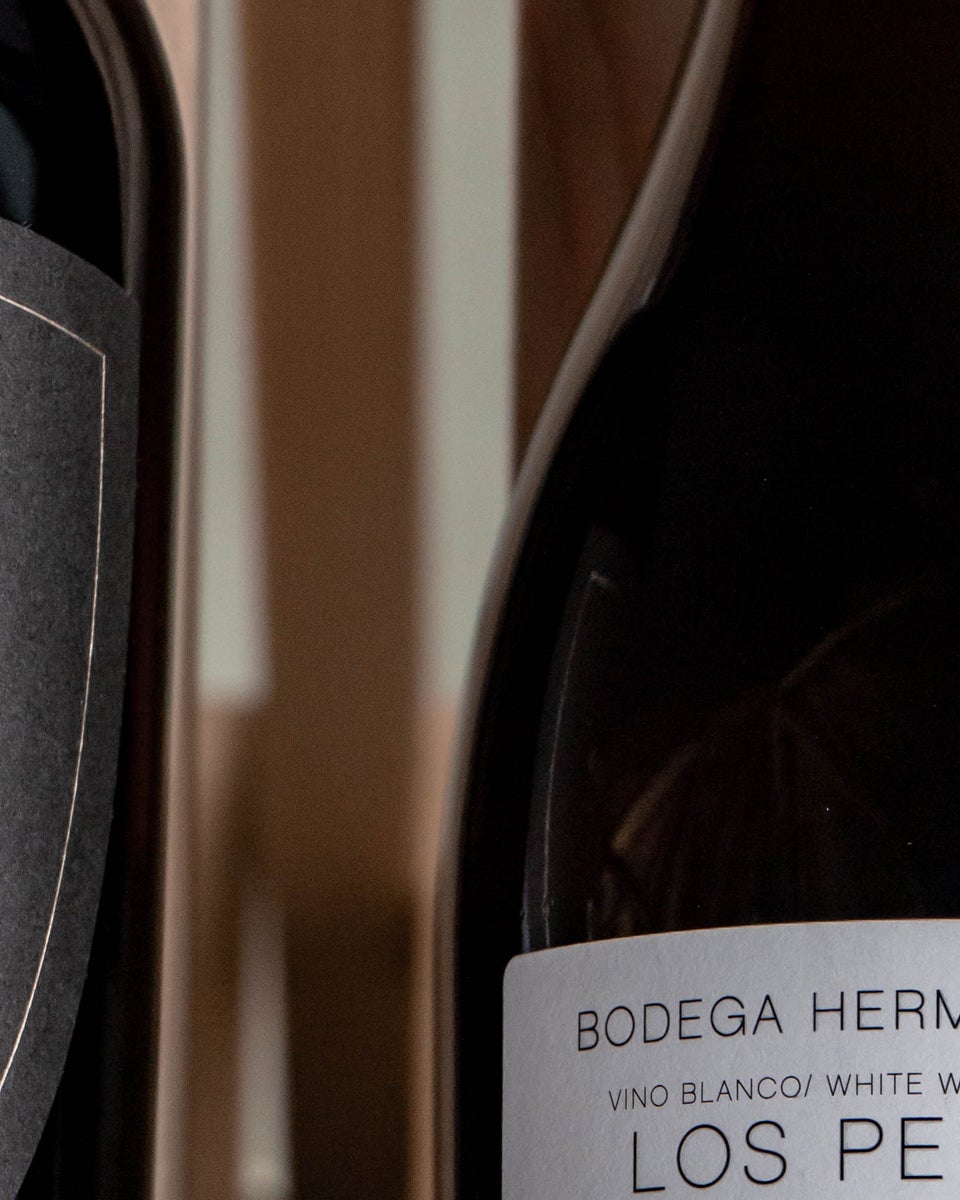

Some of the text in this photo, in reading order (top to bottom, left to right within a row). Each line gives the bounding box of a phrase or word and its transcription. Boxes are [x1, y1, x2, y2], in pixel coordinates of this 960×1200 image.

[577, 993, 784, 1053] BODEGA
[608, 1083, 669, 1112] VINO
[681, 1073, 813, 1106] BLANCO/
[825, 1071, 923, 1097] WHITE
[632, 1119, 788, 1195] LOS
